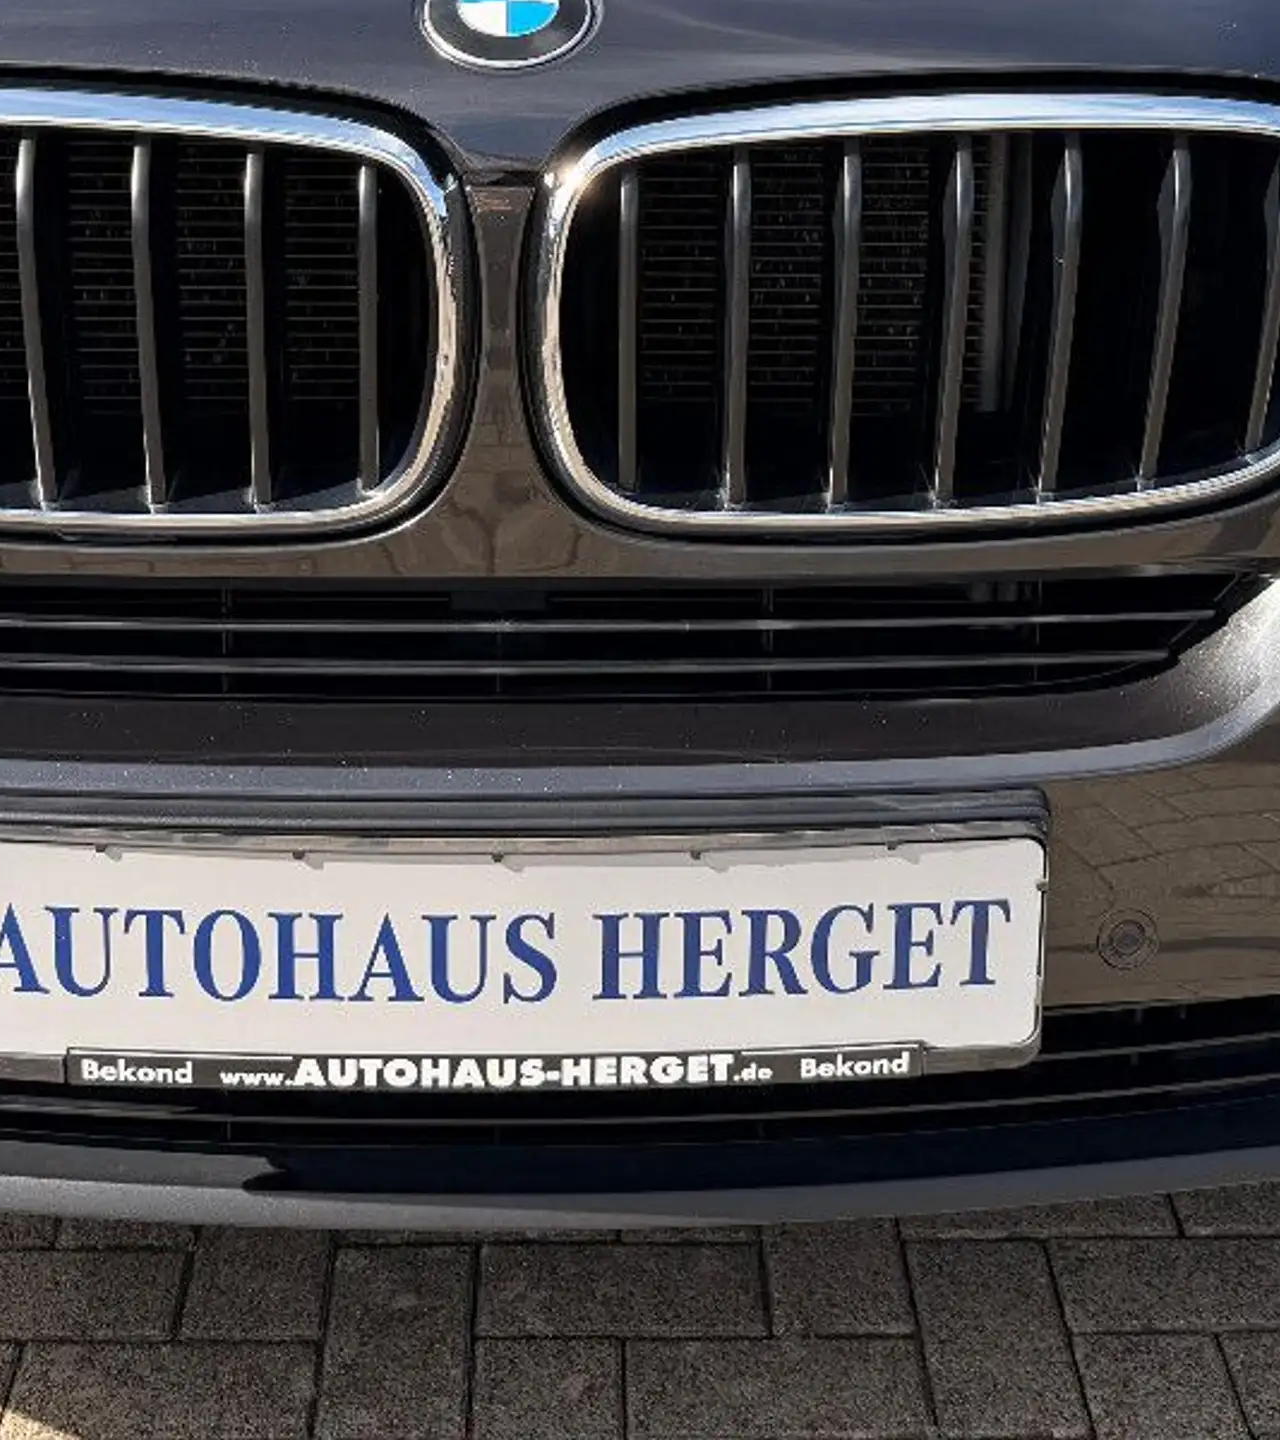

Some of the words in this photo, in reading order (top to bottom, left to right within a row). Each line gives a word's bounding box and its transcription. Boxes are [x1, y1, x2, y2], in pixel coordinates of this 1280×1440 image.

[592, 898, 1013, 1001] HERGET
[80, 1058, 194, 1085] Bekond
[220, 1054, 774, 1088] www.AUTOHAUS-HERGET.de
[799, 1051, 911, 1080] Bekond
